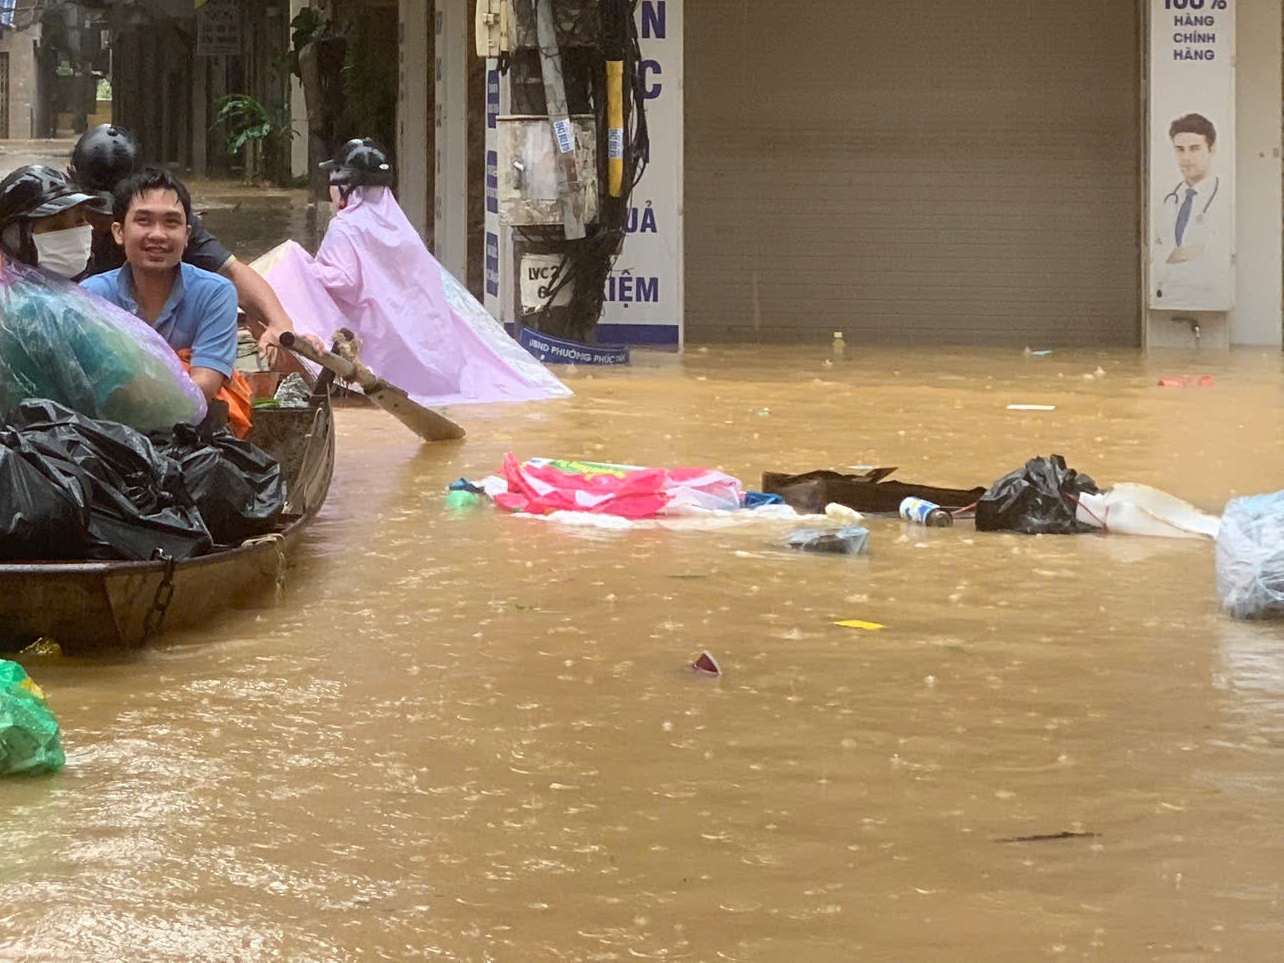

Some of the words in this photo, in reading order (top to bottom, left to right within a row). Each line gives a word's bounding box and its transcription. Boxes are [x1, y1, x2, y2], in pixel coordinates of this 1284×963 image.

[1174, 13, 1215, 26] HÀNG
[1173, 30, 1216, 43] CHÍNH
[603, 268, 658, 308] IỆM
